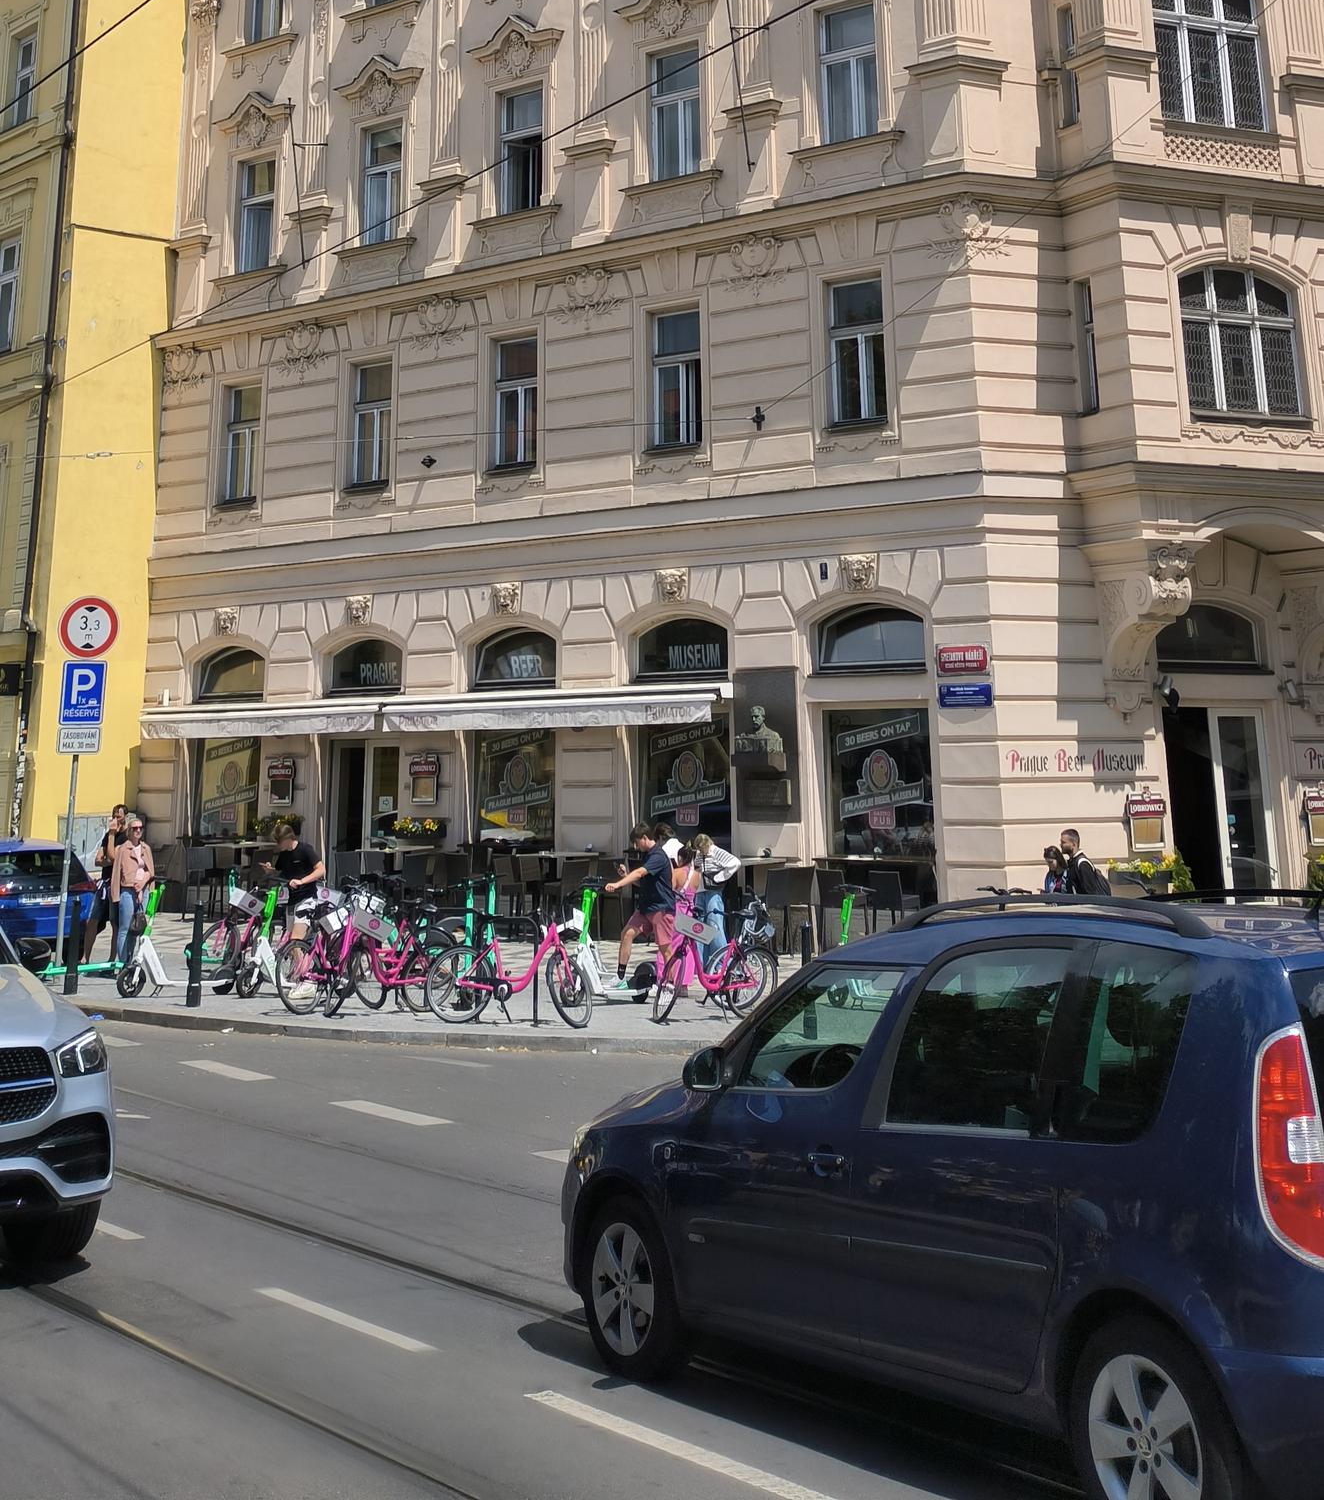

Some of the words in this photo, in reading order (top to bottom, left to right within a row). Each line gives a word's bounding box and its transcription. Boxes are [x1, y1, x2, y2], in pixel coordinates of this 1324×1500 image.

[511, 655, 544, 678] BEER
[669, 644, 720, 669] MUSEUM
[360, 661, 398, 684] PRAGUE
[70, 668, 97, 705] P
[520, 734, 530, 743] ON
[658, 738, 666, 748] 30
[668, 733, 687, 745] BEERS
[689, 729, 700, 739] ON
[844, 736, 855, 746] 30
[856, 730, 879, 743] BEERS
[880, 726, 894, 738] ON
[896, 722, 910, 734] TAP
[1006, 750, 1048, 776] Prague
[1054, 749, 1086, 773] Beer
[655, 797, 680, 809] PRAGUE
[682, 794, 696, 804] BEER
[696, 788, 722, 800] MUSEUM
[844, 800, 873, 812] PRAGUE
[874, 796, 890, 807] BEER
[892, 788, 920, 803] MUSEUM
[873, 816, 891, 825] PUB
